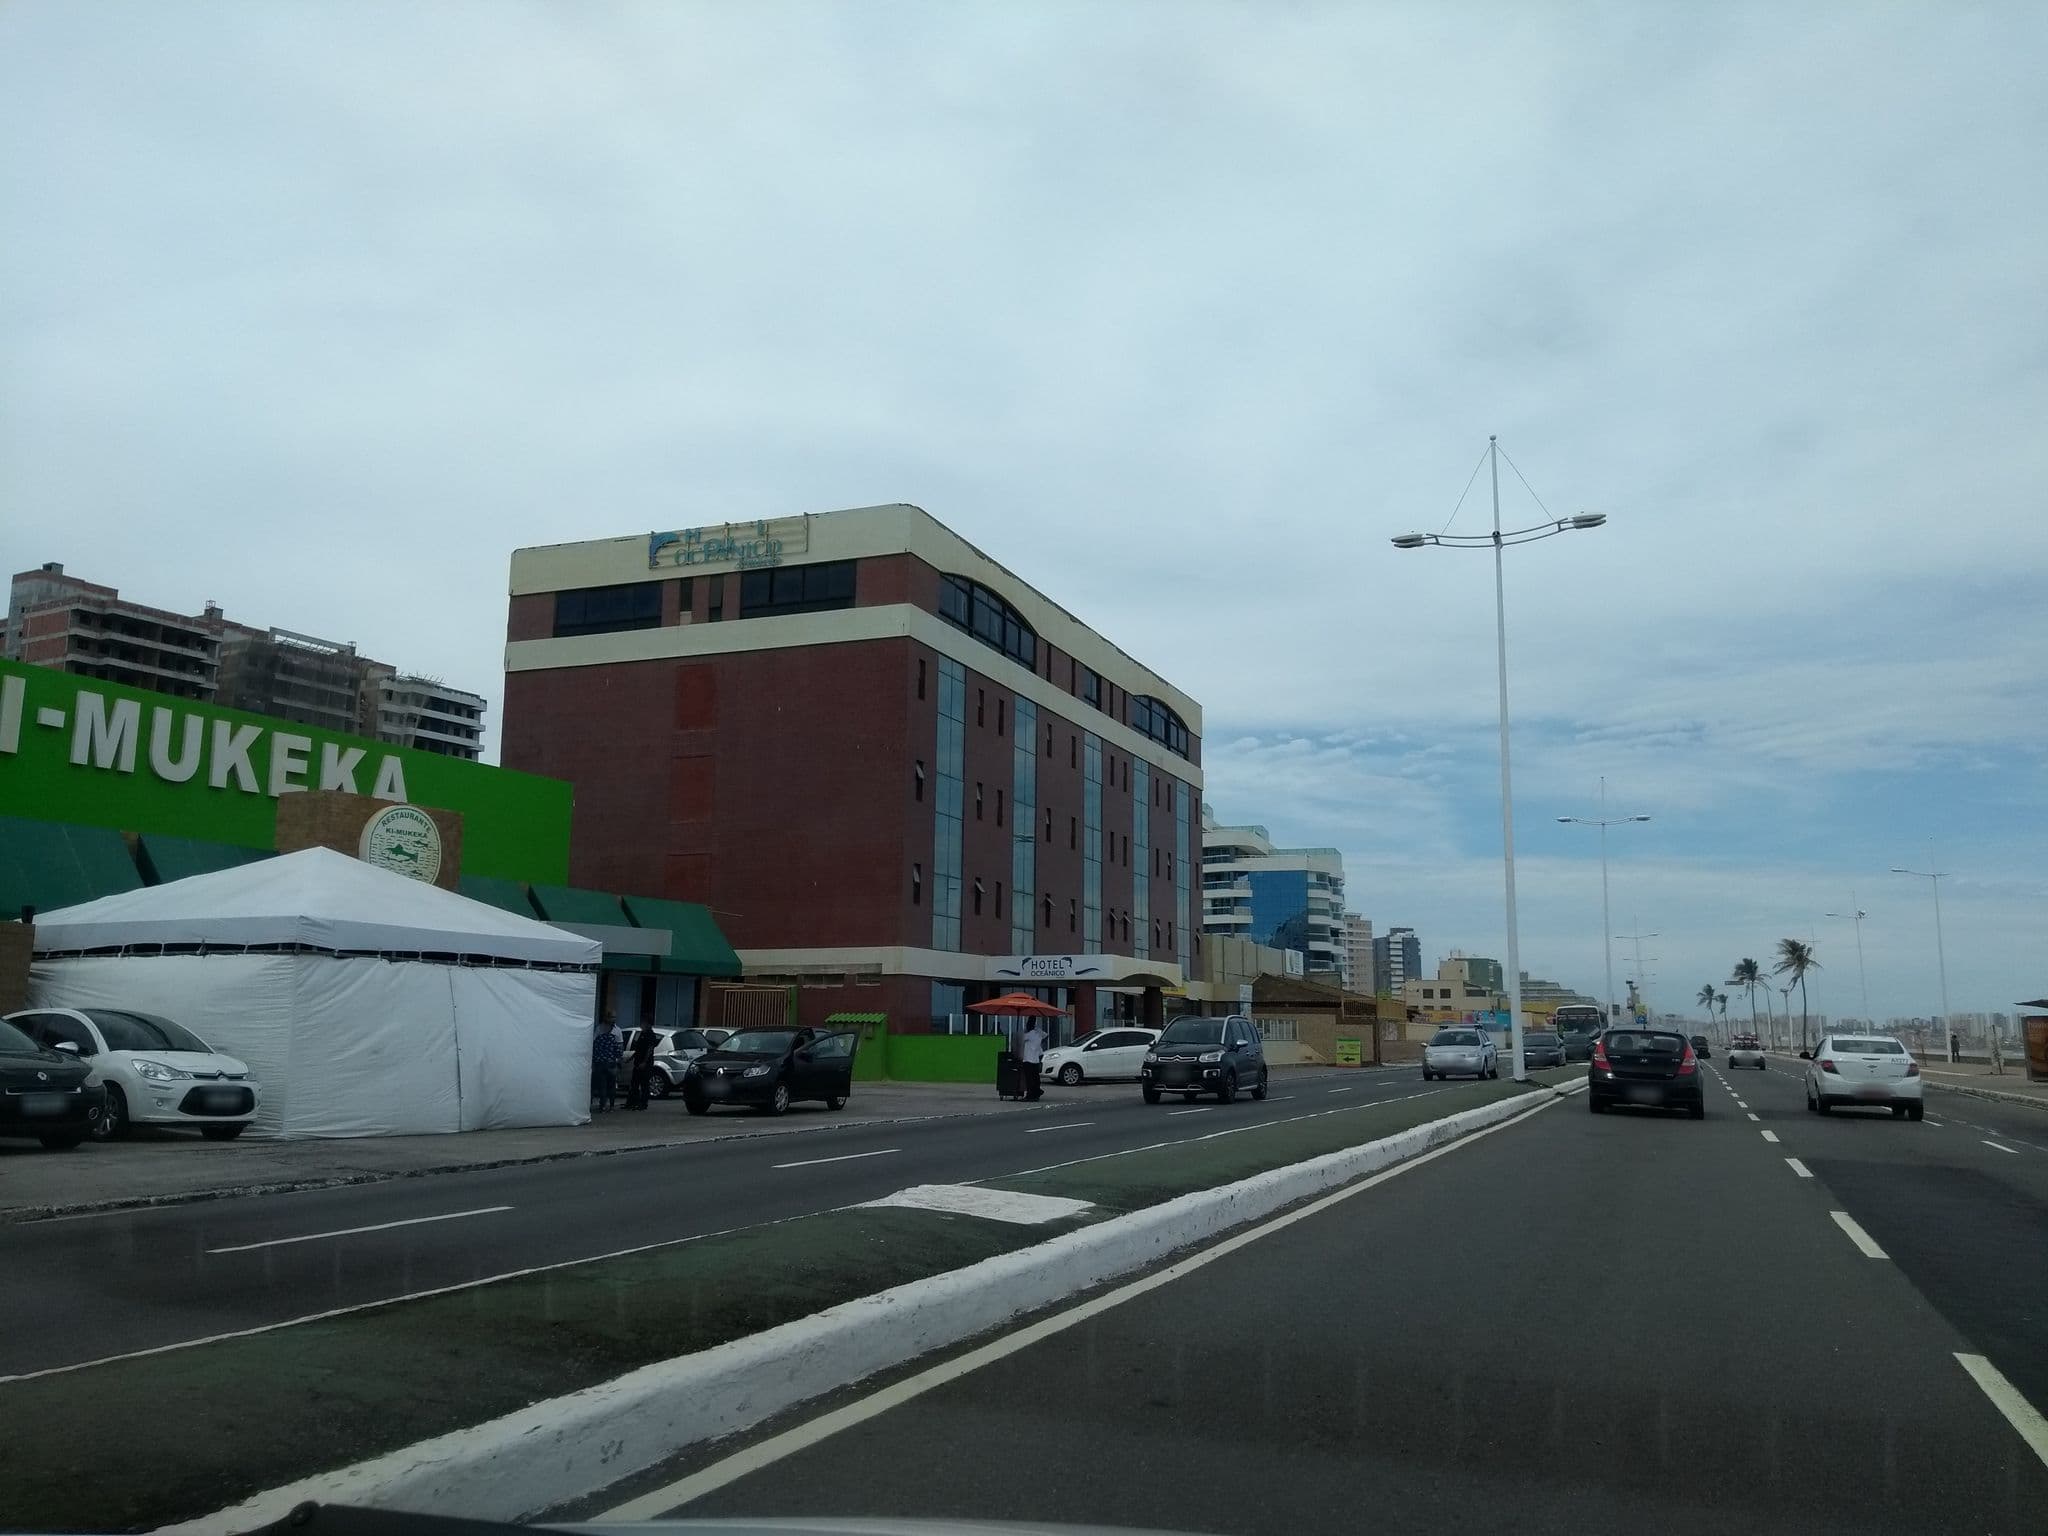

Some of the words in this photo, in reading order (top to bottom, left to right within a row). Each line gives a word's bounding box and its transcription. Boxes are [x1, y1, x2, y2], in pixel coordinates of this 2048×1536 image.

[381, 811, 431, 833] RESTAURANTE
[385, 827, 428, 839] KI-MUKEKA
[1031, 959, 1064, 970] HOTEL
